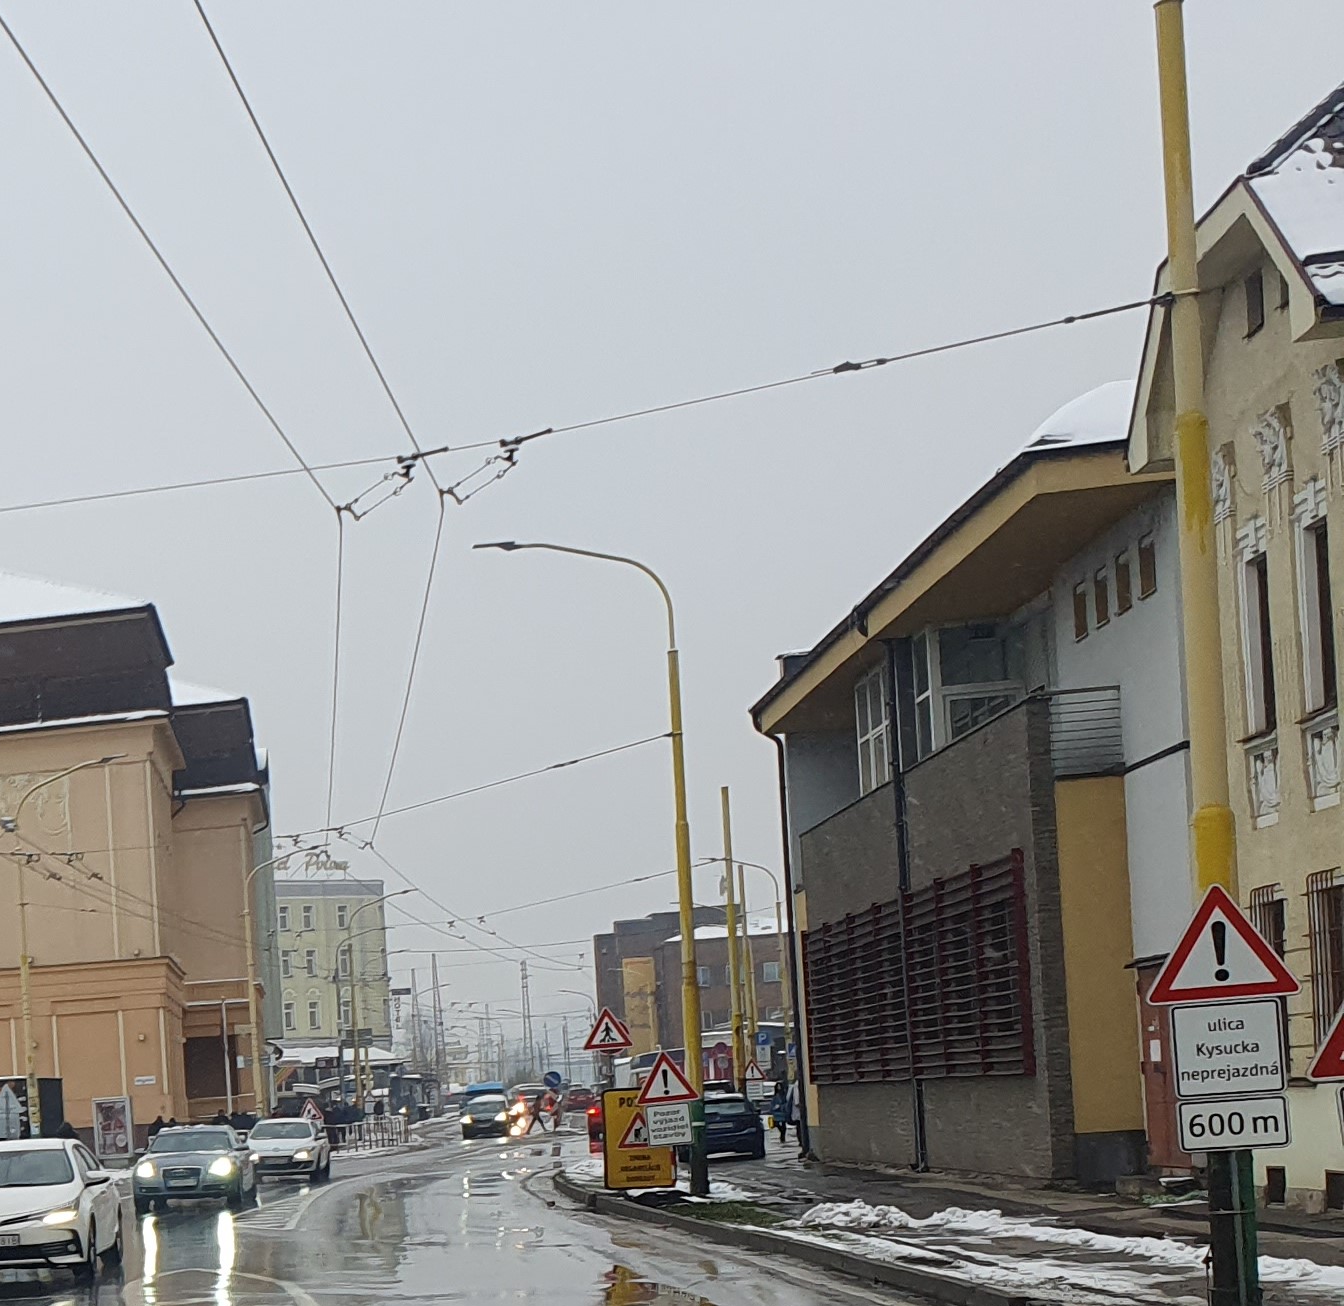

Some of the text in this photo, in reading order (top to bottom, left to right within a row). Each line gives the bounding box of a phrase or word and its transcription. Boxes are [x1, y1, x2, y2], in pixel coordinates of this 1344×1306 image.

[1207, 1018, 1245, 1032] ulica
[1196, 1041, 1260, 1059] Kysucka
[1181, 1061, 1279, 1083] neprejazdná
[1189, 1111, 1279, 1138] 600 m
